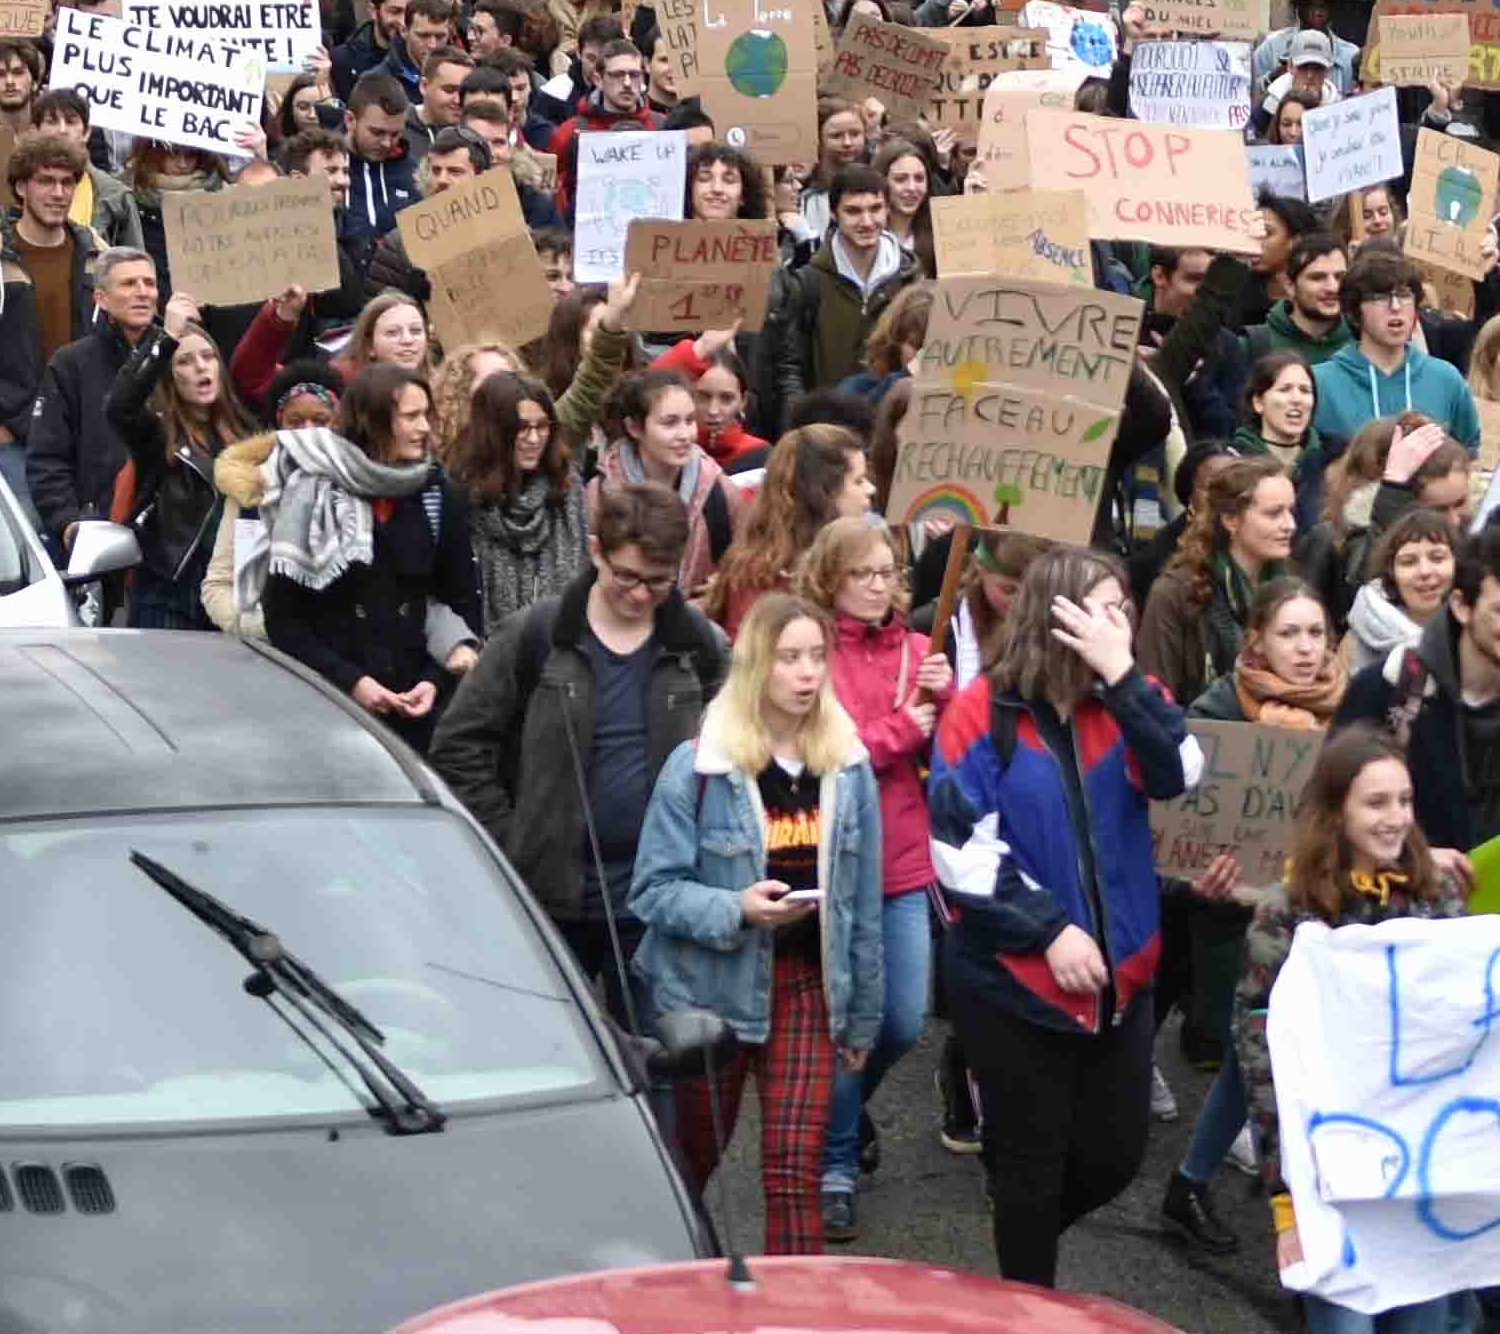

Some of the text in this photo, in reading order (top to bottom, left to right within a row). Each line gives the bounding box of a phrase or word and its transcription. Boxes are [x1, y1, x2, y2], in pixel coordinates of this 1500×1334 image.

[129, 3, 313, 29] JE VOUDRAI ETRE
[1178, 14, 1214, 30] MIEL
[63, 42, 133, 78] PLUS
[66, 12, 104, 41] LE
[122, 27, 242, 69] CLIMAT
[73, 82, 231, 143] QUE LE BAC
[138, 71, 261, 116] IMPORTANT
[1228, 105, 1251, 128] PAS
[592, 143, 643, 165] WAKE
[1063, 123, 1191, 180] STOP
[416, 185, 500, 242] QUAND
[1114, 198, 1253, 235] CONNERIES
[651, 226, 775, 264] PLANÈTE
[944, 288, 1139, 351] VIVRE
[921, 334, 1129, 381] AUTREMENT
[920, 394, 1075, 436] FACE AU
